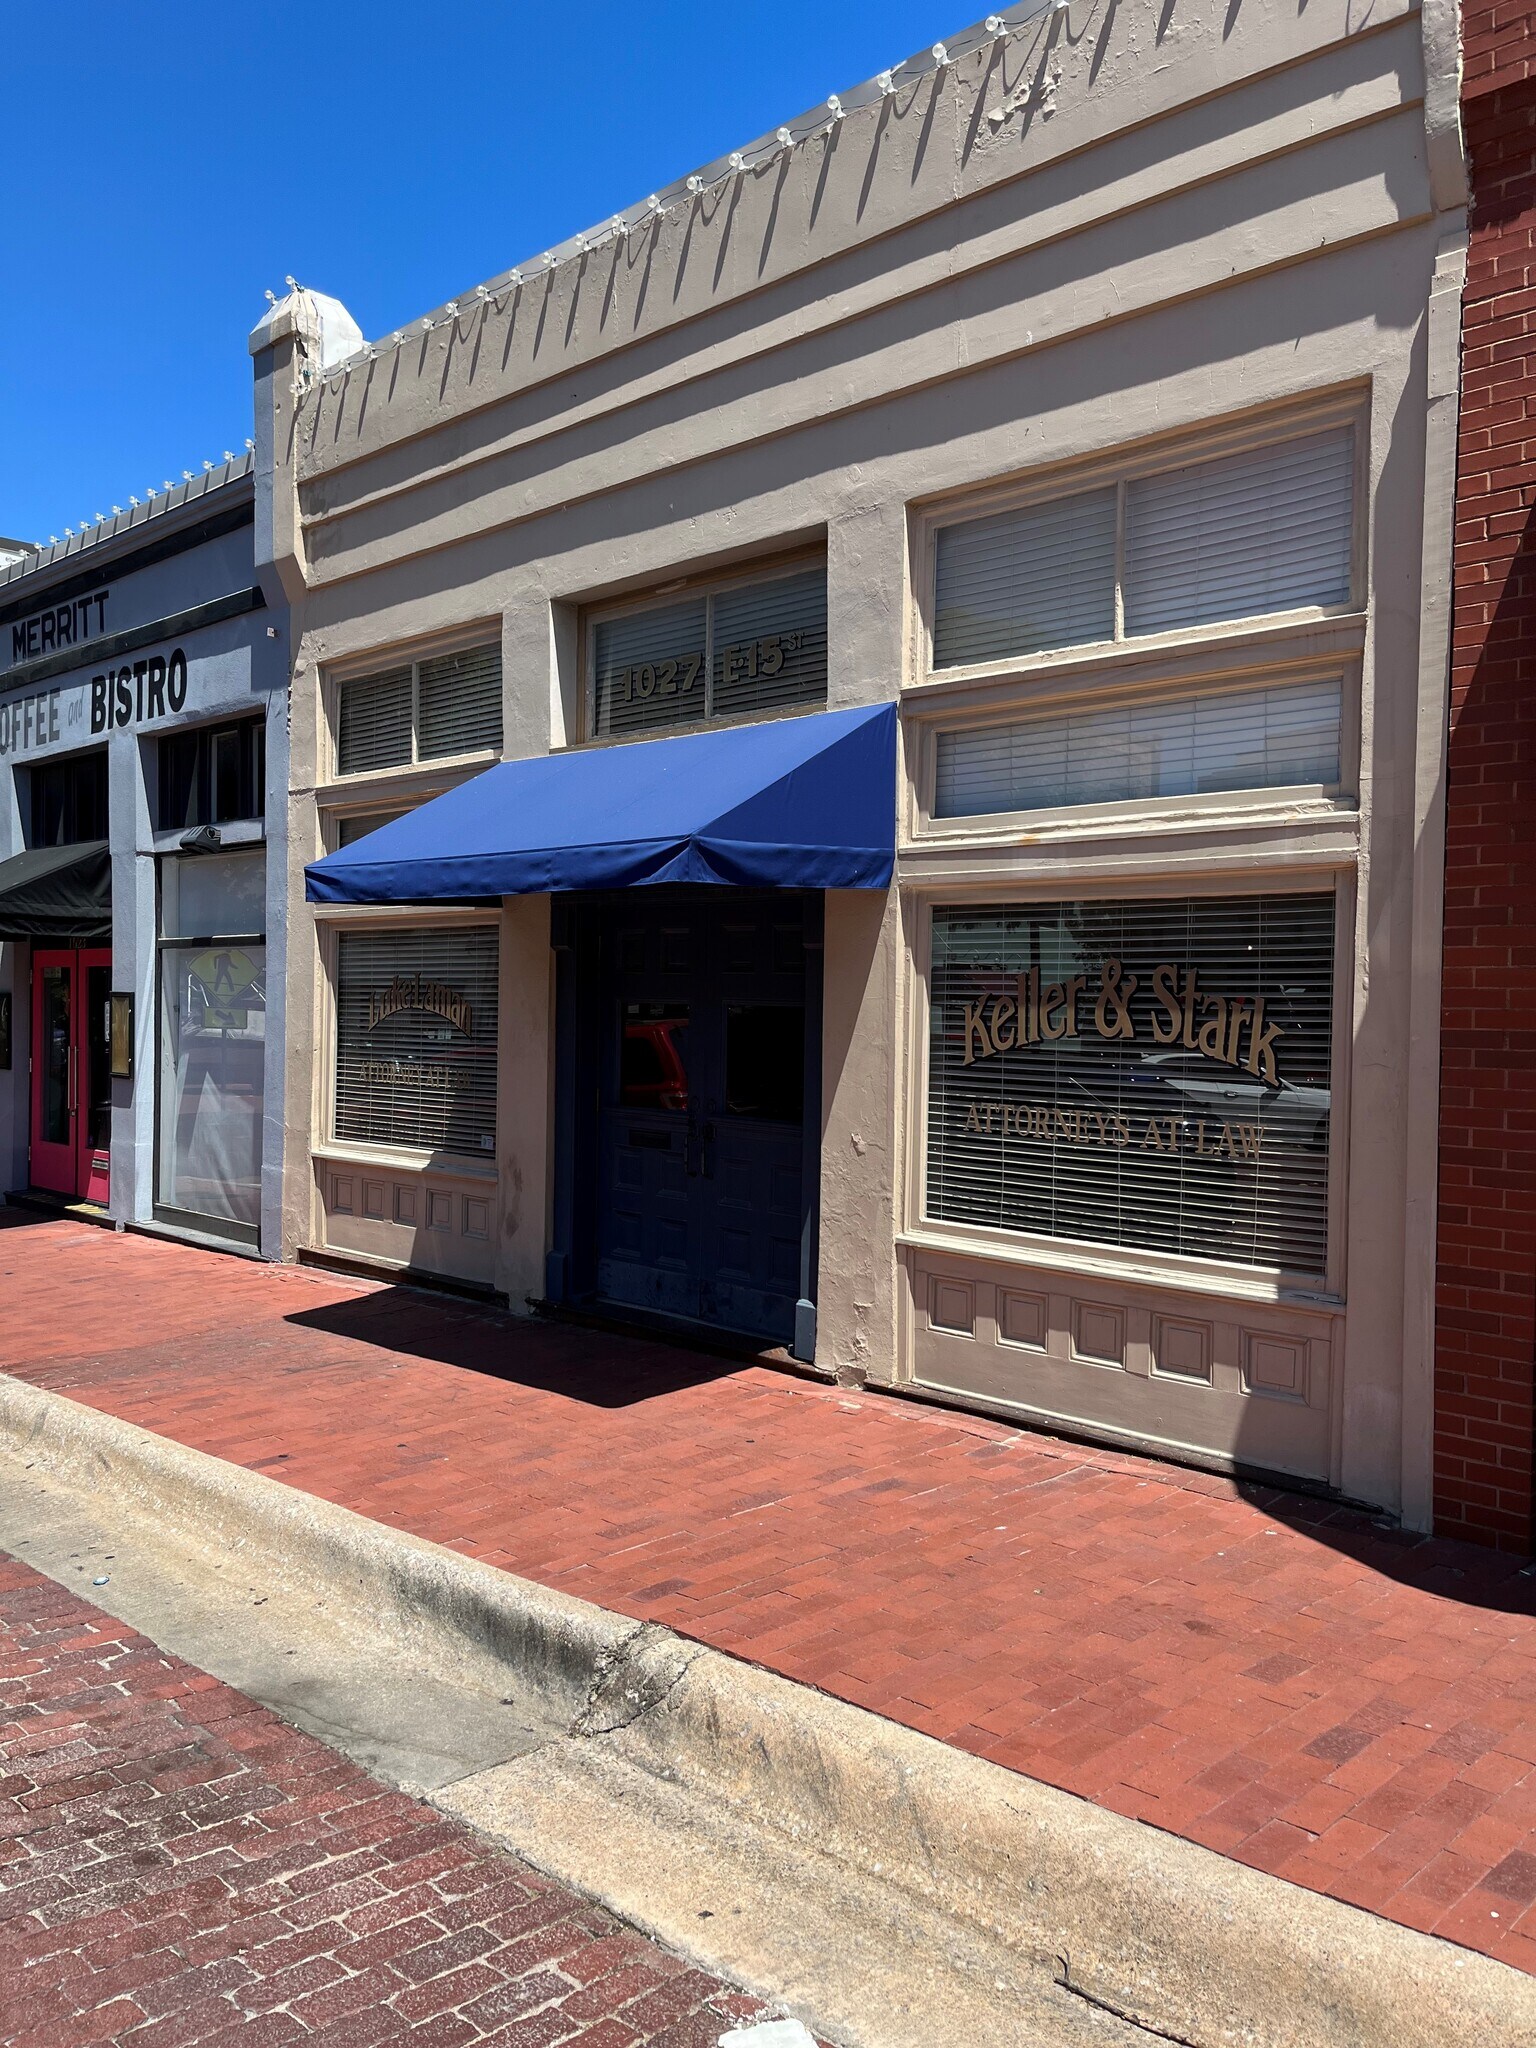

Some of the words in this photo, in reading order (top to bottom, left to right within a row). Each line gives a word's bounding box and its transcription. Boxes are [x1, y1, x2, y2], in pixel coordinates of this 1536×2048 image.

[12, 590, 110, 663] MERRITT
[68, 687, 85, 727] and
[90, 647, 188, 735] BISTRO
[622, 652, 704, 702] 1027
[368, 974, 412, 1032] Luke
[962, 965, 1087, 1067] Keller
[1093, 957, 1138, 1040] &
[1150, 963, 1286, 1089] Stark
[426, 1066, 445, 1088] AT
[963, 1101, 1130, 1148] ATTORNEYS
[1140, 1115, 1185, 1151] AT
[1194, 1119, 1268, 1160] LAW
